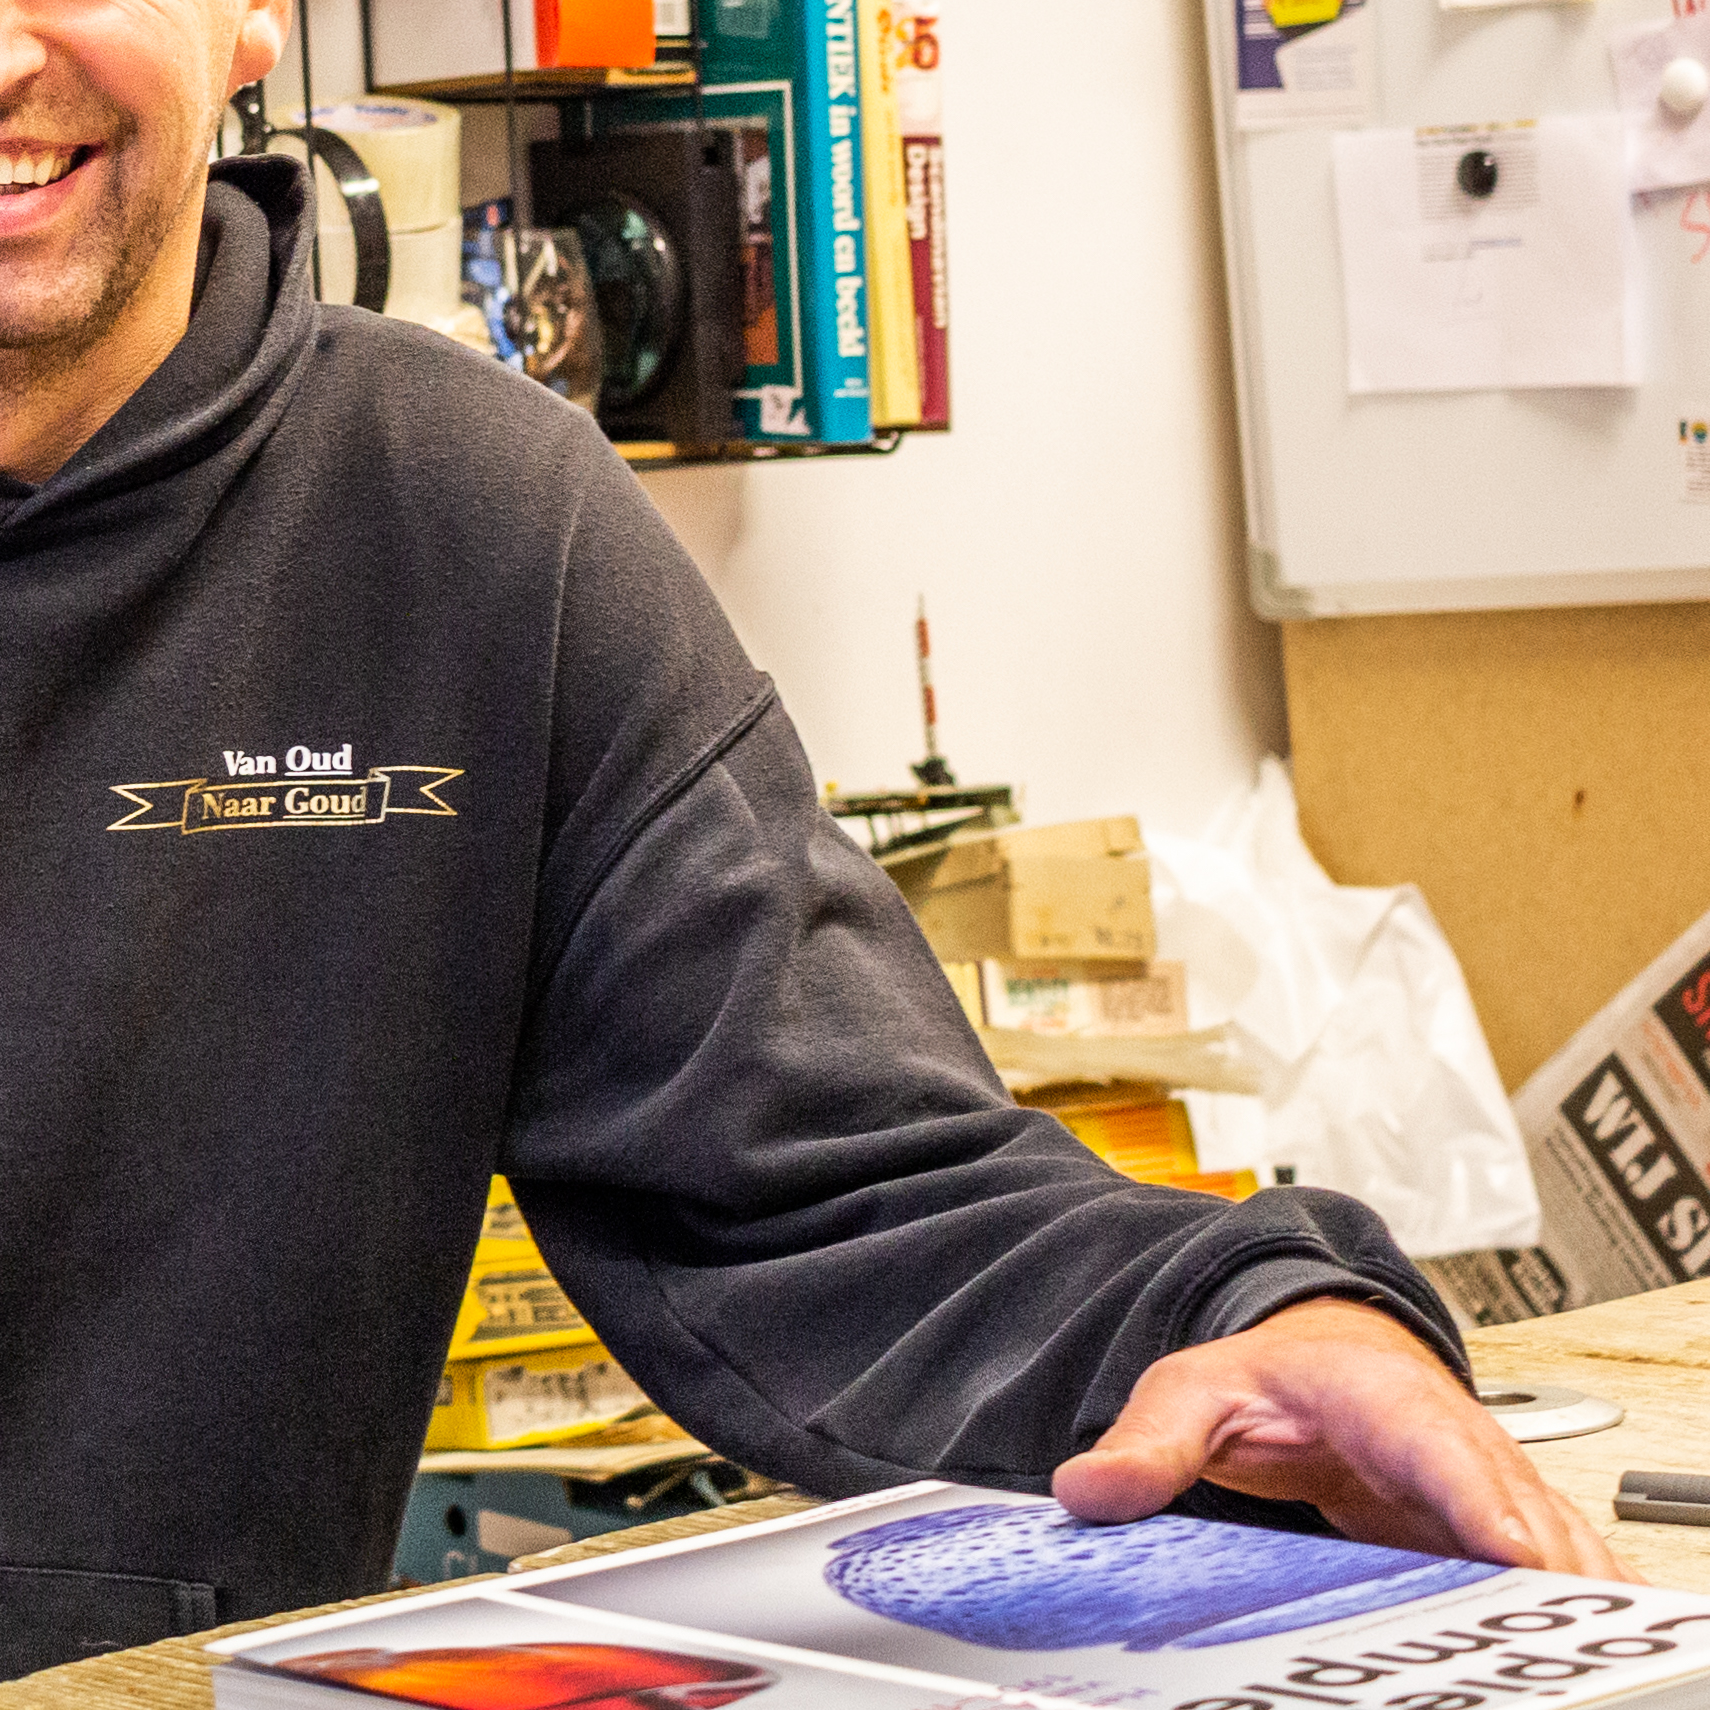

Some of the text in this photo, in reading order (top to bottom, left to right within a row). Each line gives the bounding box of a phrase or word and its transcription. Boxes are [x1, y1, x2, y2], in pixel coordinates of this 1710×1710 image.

[828, 104, 858, 139] in
[830, 138, 861, 232] woord
[903, 142, 929, 240] Design
[222, 743, 353, 777] Van Oud
[201, 785, 367, 821] Naar Goud
[1583, 1068, 1679, 1201] WIJ
